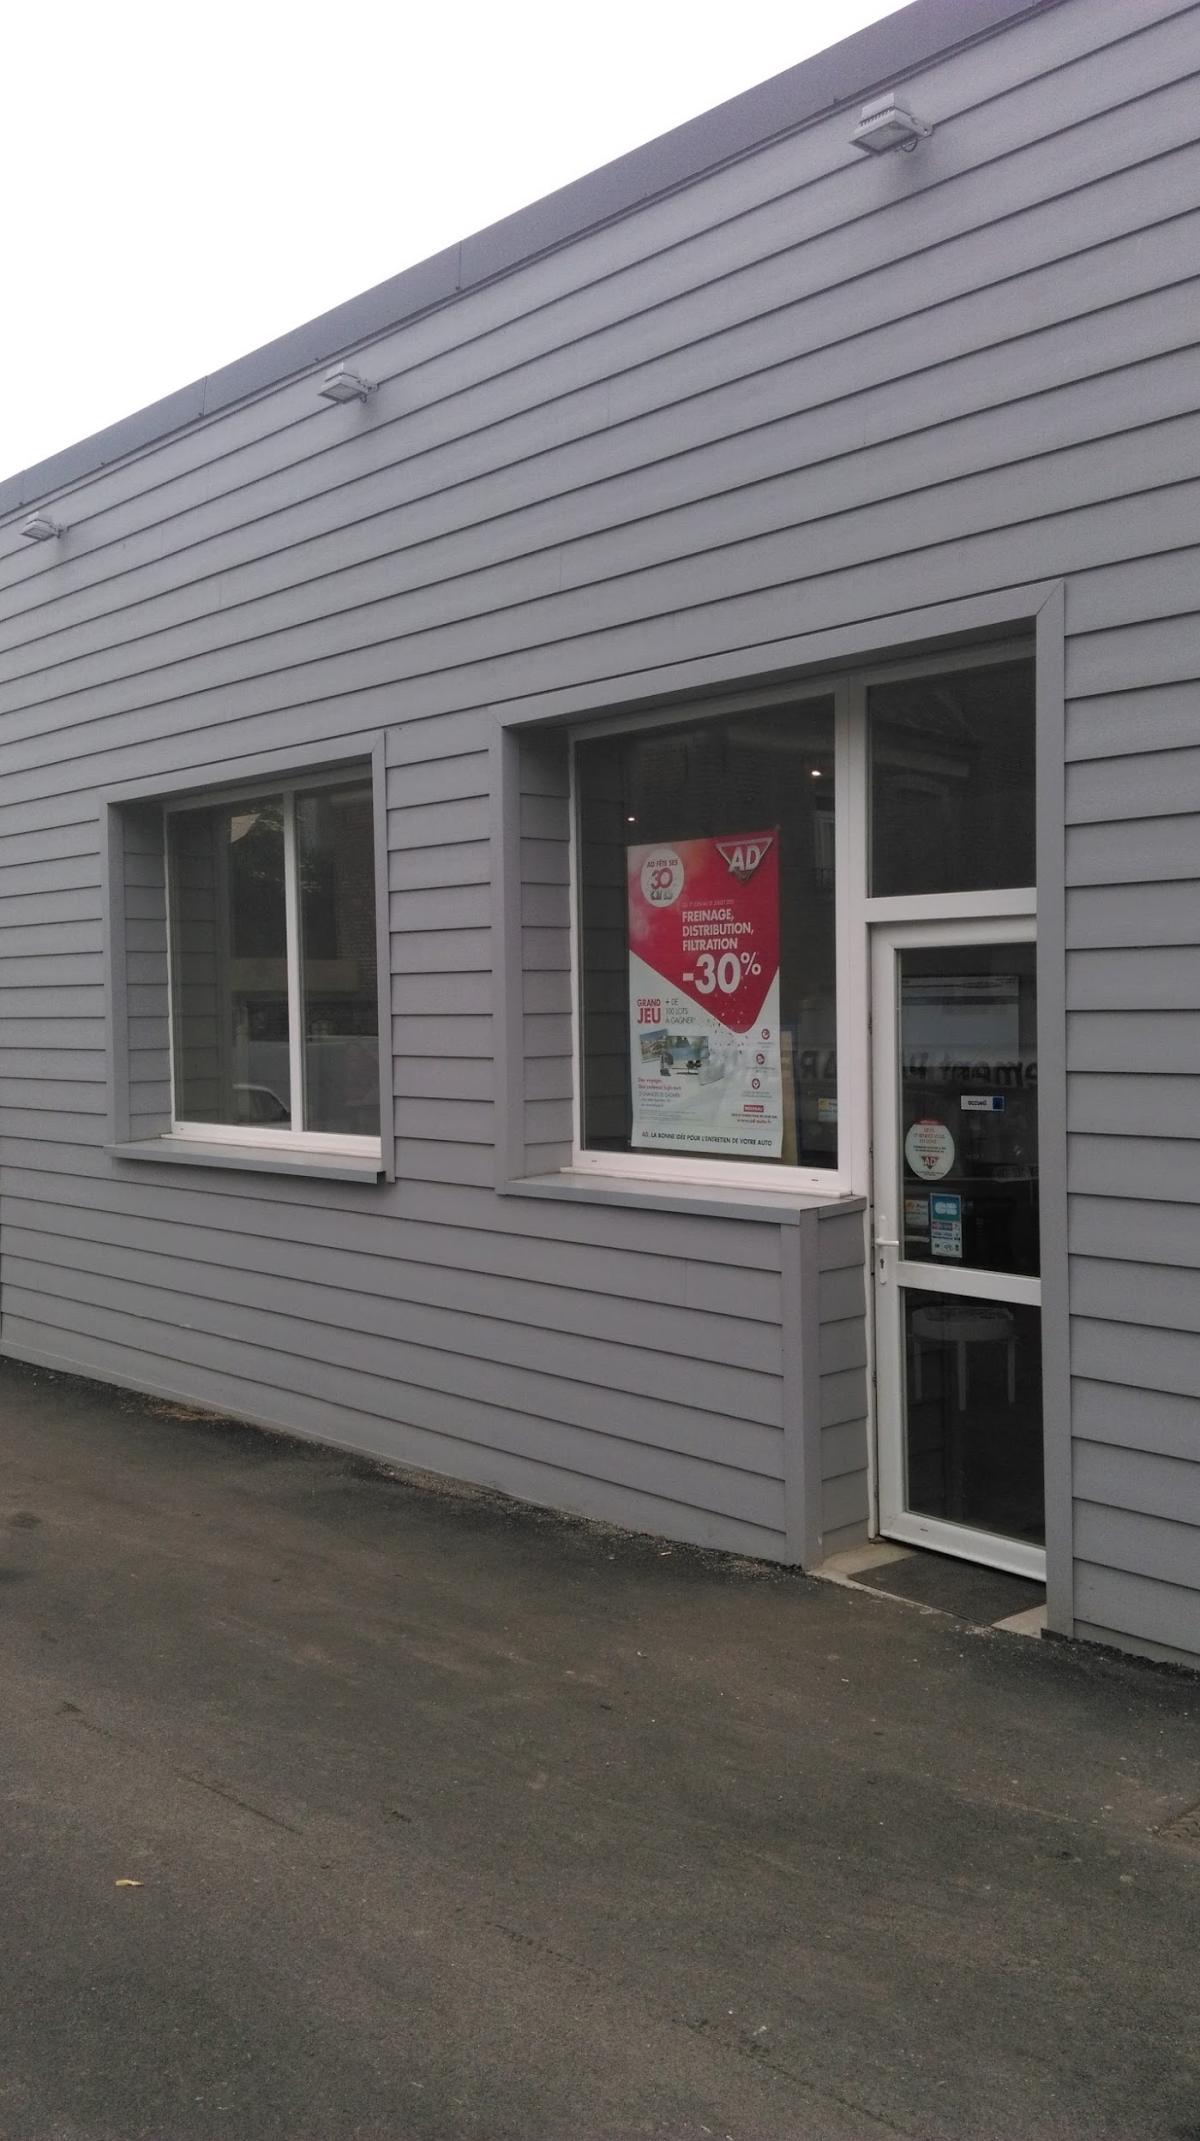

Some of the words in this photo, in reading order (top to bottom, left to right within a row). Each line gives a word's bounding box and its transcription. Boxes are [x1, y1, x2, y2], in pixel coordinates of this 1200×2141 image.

[729, 844, 761, 872] AD
[650, 867, 673, 890] 30
[682, 908, 734, 923] FREINAGE,
[682, 922, 754, 937] DISTRIBUTION,
[682, 937, 738, 951] FILTRATION
[637, 998, 661, 1007] GRAND
[637, 1007, 661, 1024] JEU
[658, 1132, 675, 1140] BONNE
[686, 1134, 700, 1142] POUR
[701, 1136, 731, 1144] L'ENTRETIEN
[757, 1139, 773, 1147] AUTO
